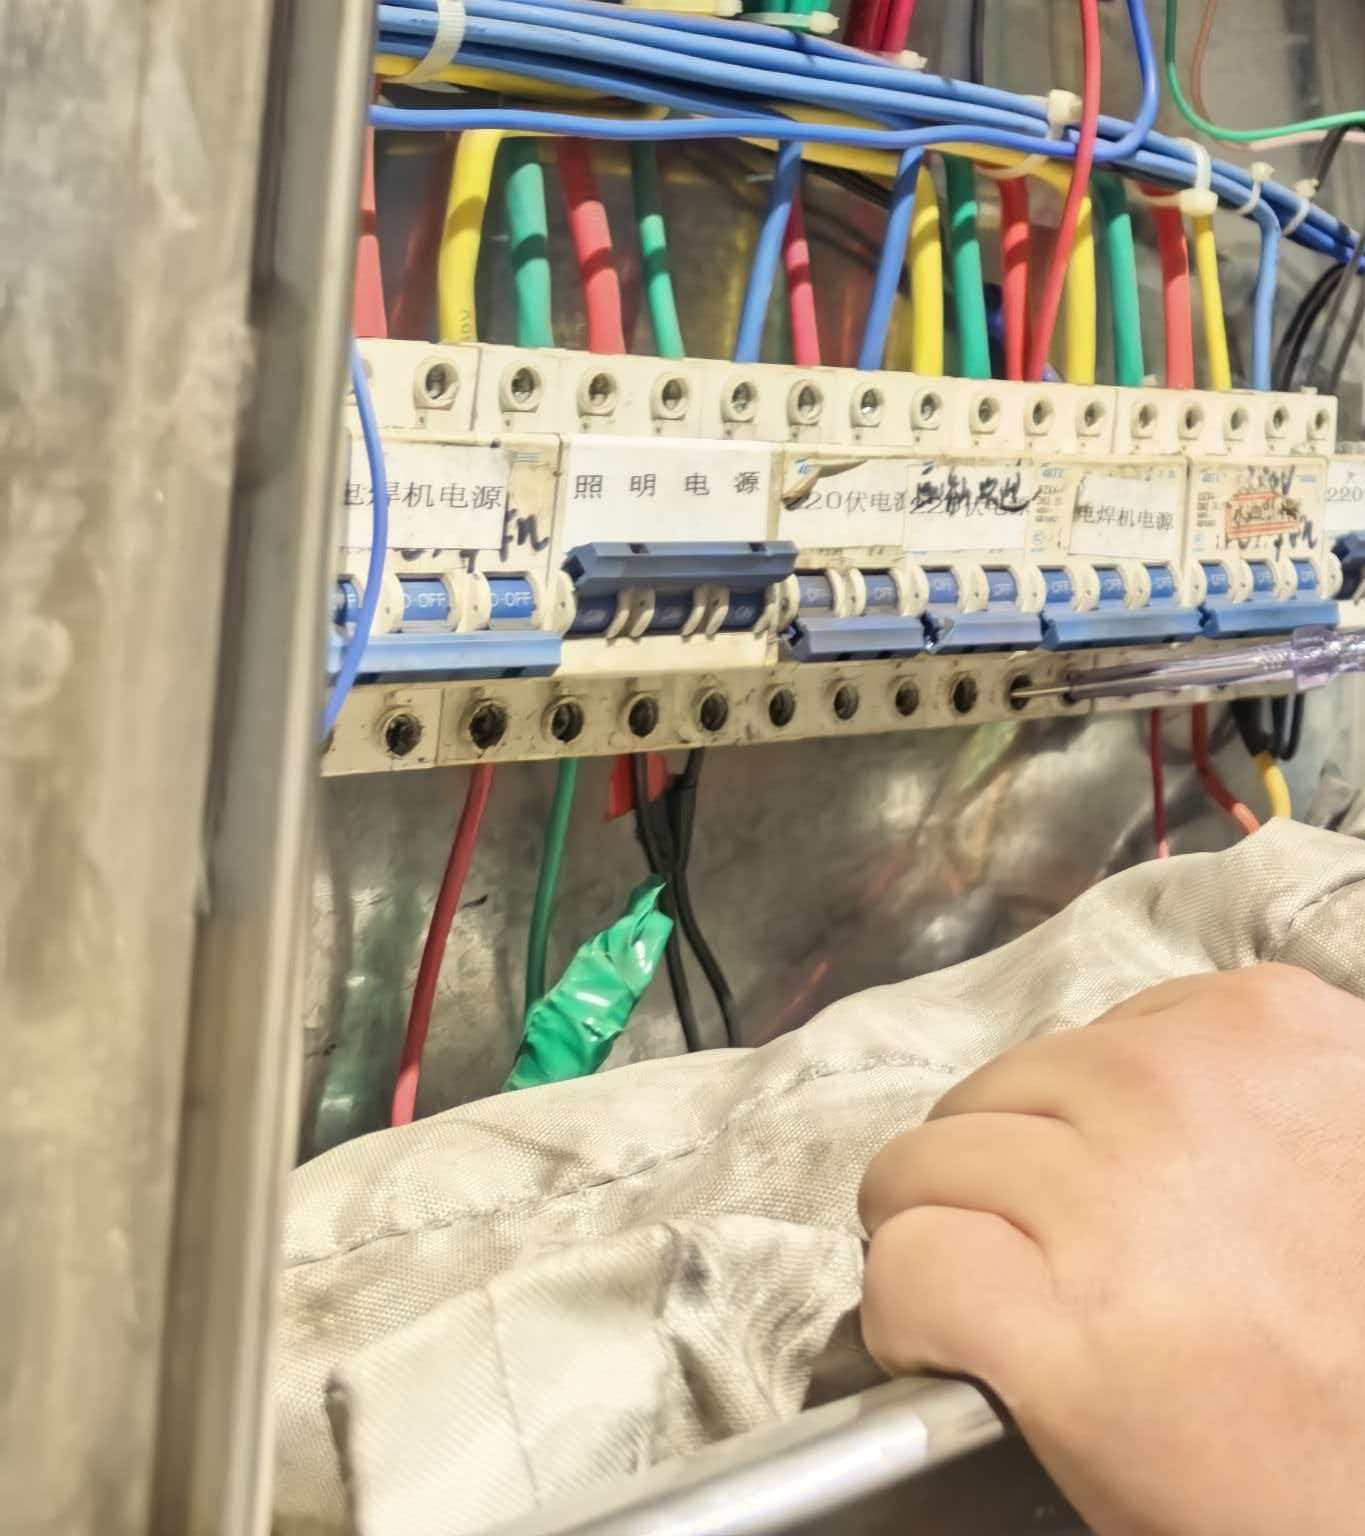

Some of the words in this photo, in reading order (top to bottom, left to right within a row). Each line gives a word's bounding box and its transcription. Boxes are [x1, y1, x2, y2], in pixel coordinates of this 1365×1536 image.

[574, 471, 761, 500] 照明电源
[798, 490, 906, 513] 20伏电
